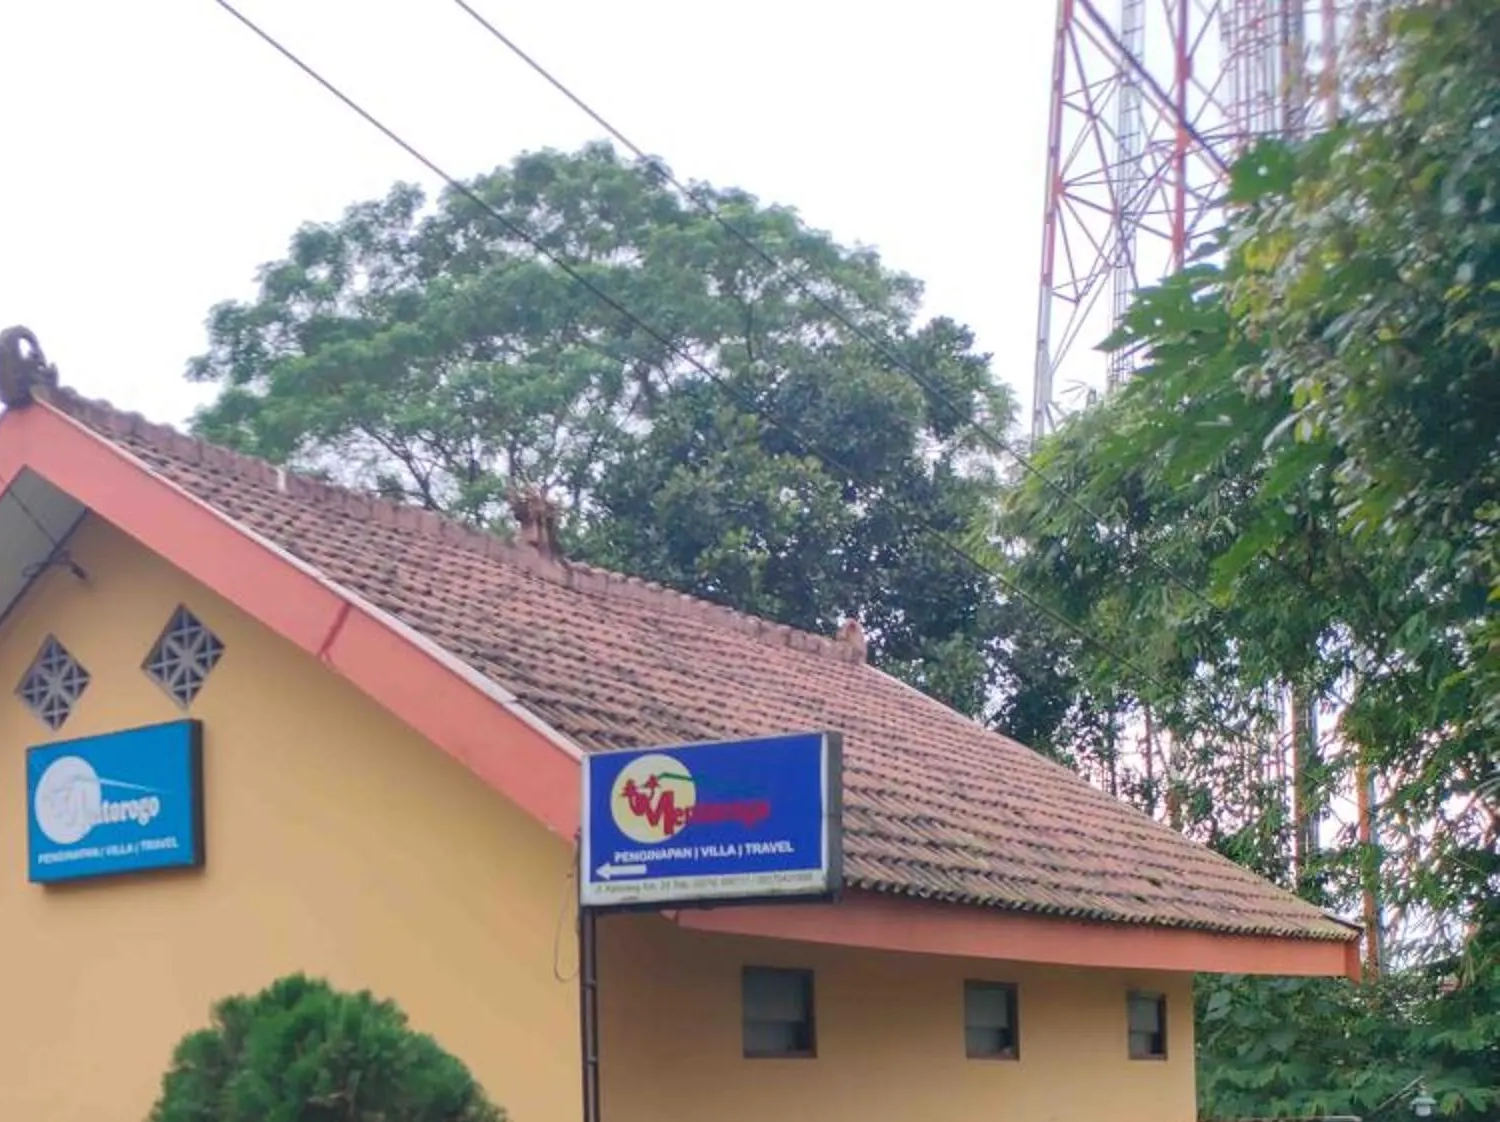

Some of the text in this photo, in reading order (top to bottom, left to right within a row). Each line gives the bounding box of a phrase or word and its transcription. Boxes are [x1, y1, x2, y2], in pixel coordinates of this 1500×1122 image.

[613, 840, 795, 863] PENGINAPAN VILLA TRAVEL
